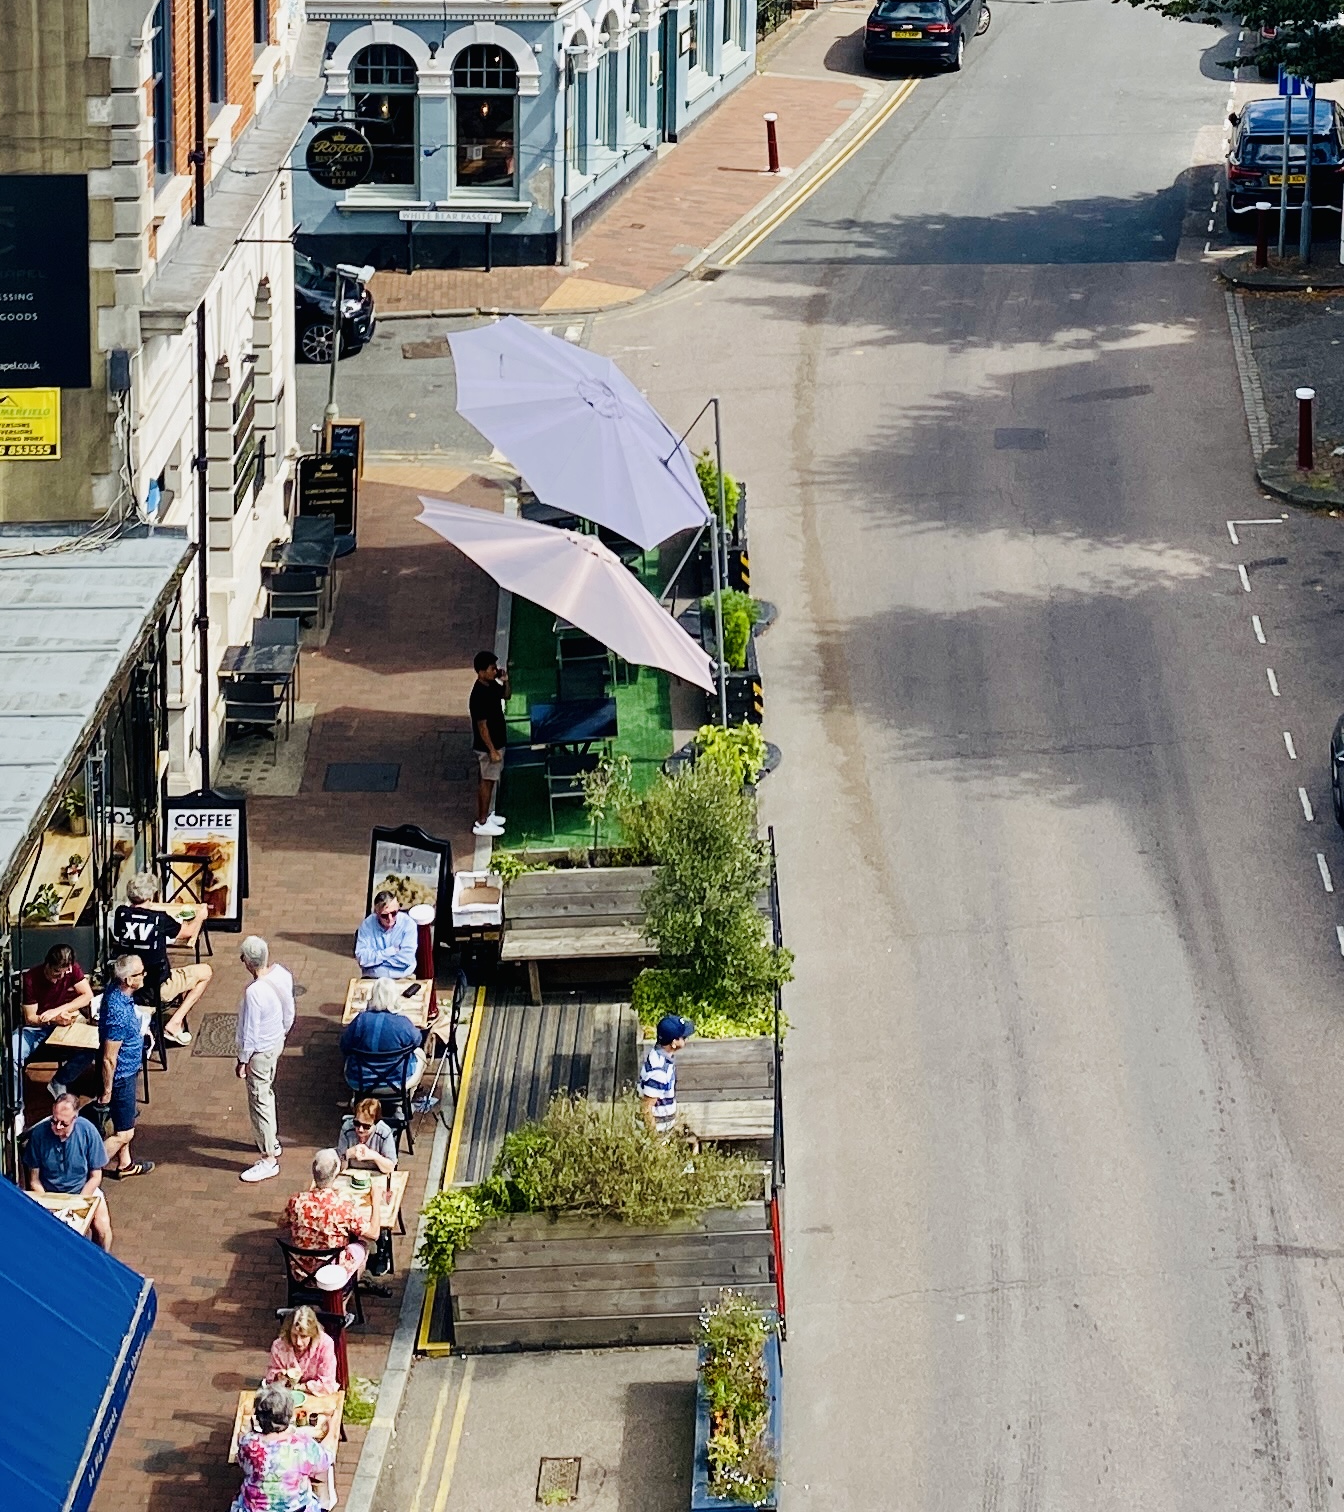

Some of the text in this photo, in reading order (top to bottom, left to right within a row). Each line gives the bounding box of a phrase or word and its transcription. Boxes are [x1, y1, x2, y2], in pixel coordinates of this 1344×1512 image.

[402, 212, 499, 222] WHITE BEAR PASSAGE
[0, 312, 38, 321] GOODS
[7, 445, 52, 455] 853555
[174, 814, 233, 827] COFFEE
[123, 921, 154, 941] XV
